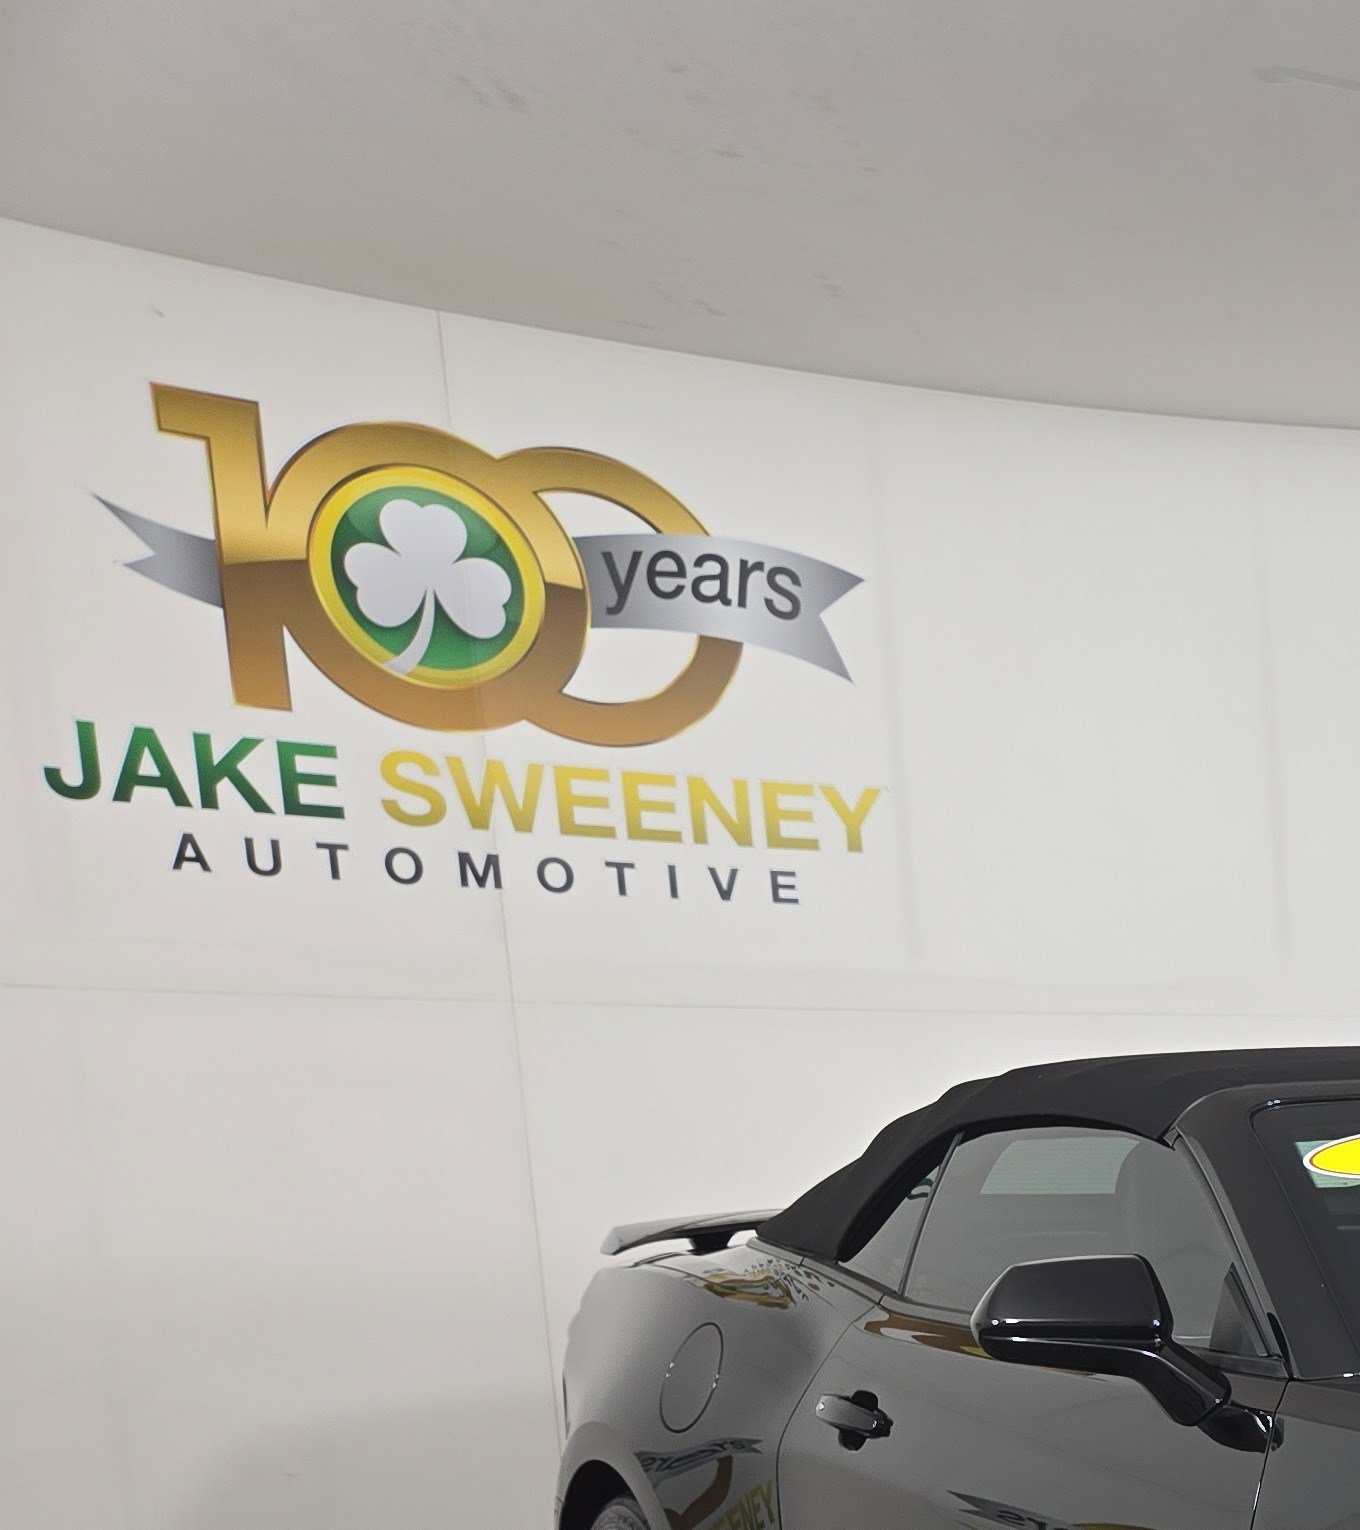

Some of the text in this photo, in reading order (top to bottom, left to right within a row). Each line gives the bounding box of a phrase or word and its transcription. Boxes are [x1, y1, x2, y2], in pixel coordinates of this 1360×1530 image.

[150, 381, 744, 747] 100
[601, 546, 803, 621] years
[43, 719, 882, 853] JAKE SWEENEY
[172, 833, 800, 904] AUTOMOTIVE
